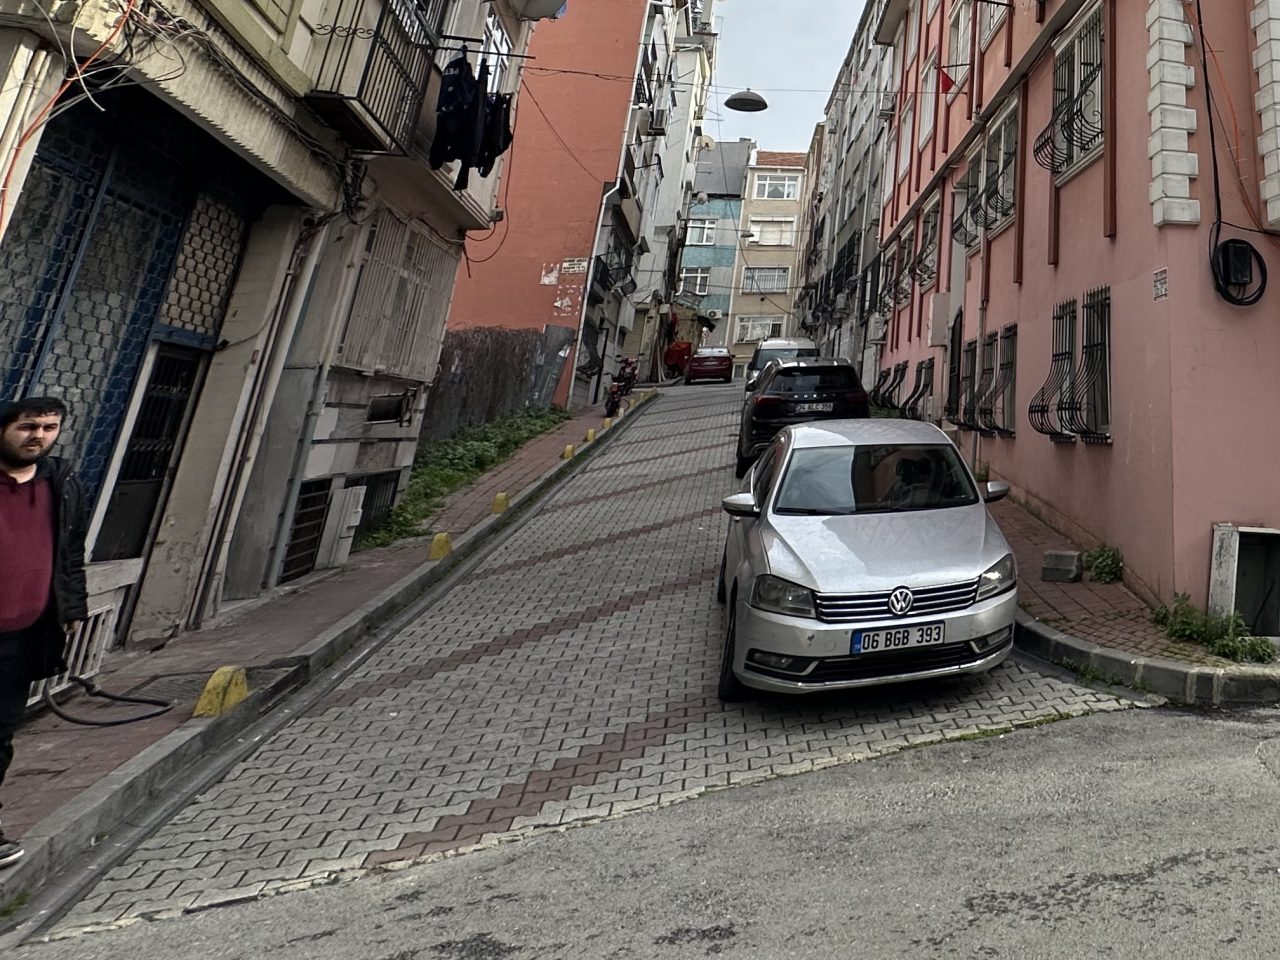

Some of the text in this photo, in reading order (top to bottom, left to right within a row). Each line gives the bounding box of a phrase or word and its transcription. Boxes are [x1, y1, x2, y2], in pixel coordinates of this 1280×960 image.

[863, 626, 941, 650] 06 BGB 393
